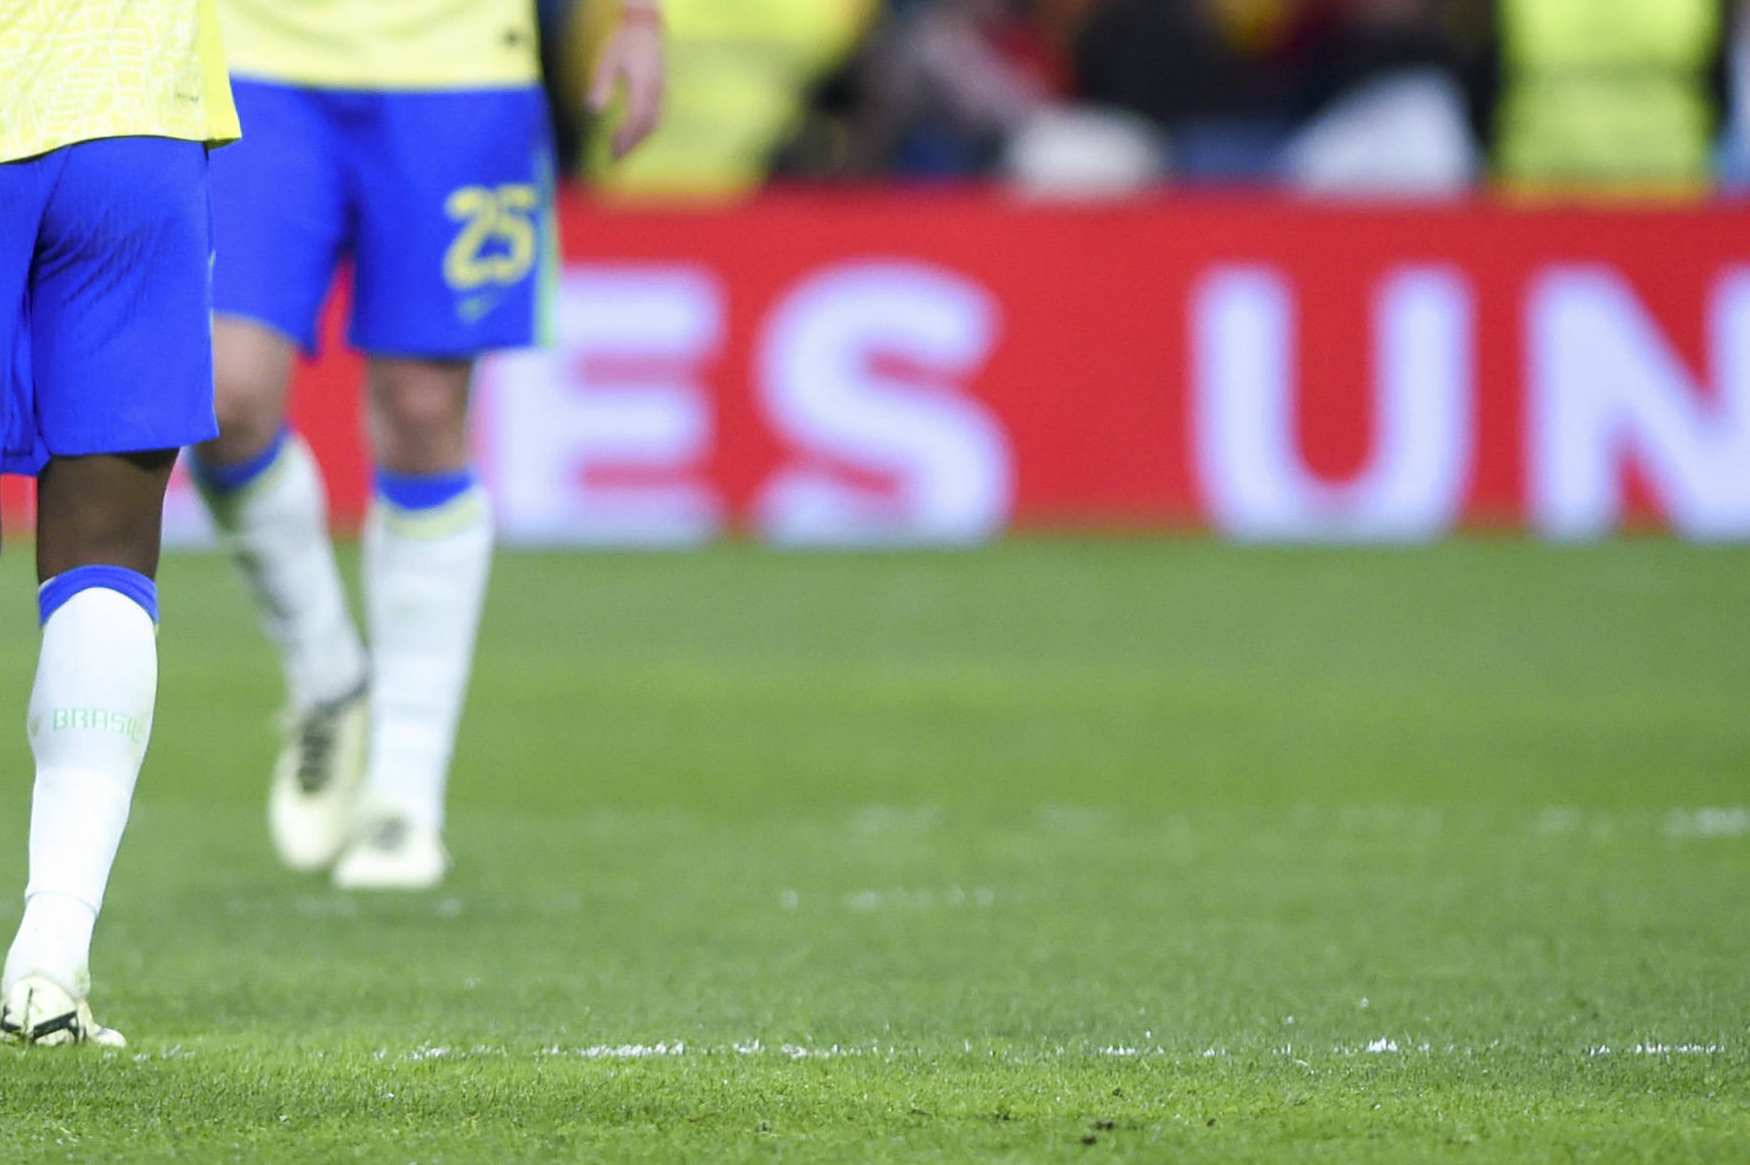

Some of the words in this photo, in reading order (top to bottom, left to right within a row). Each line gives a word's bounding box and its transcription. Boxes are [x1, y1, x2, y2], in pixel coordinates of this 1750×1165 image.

[444, 186, 536, 289] 25
[478, 257, 1013, 549] ES
[1188, 261, 1750, 545] UN
[52, 706, 139, 744] BRASIL
